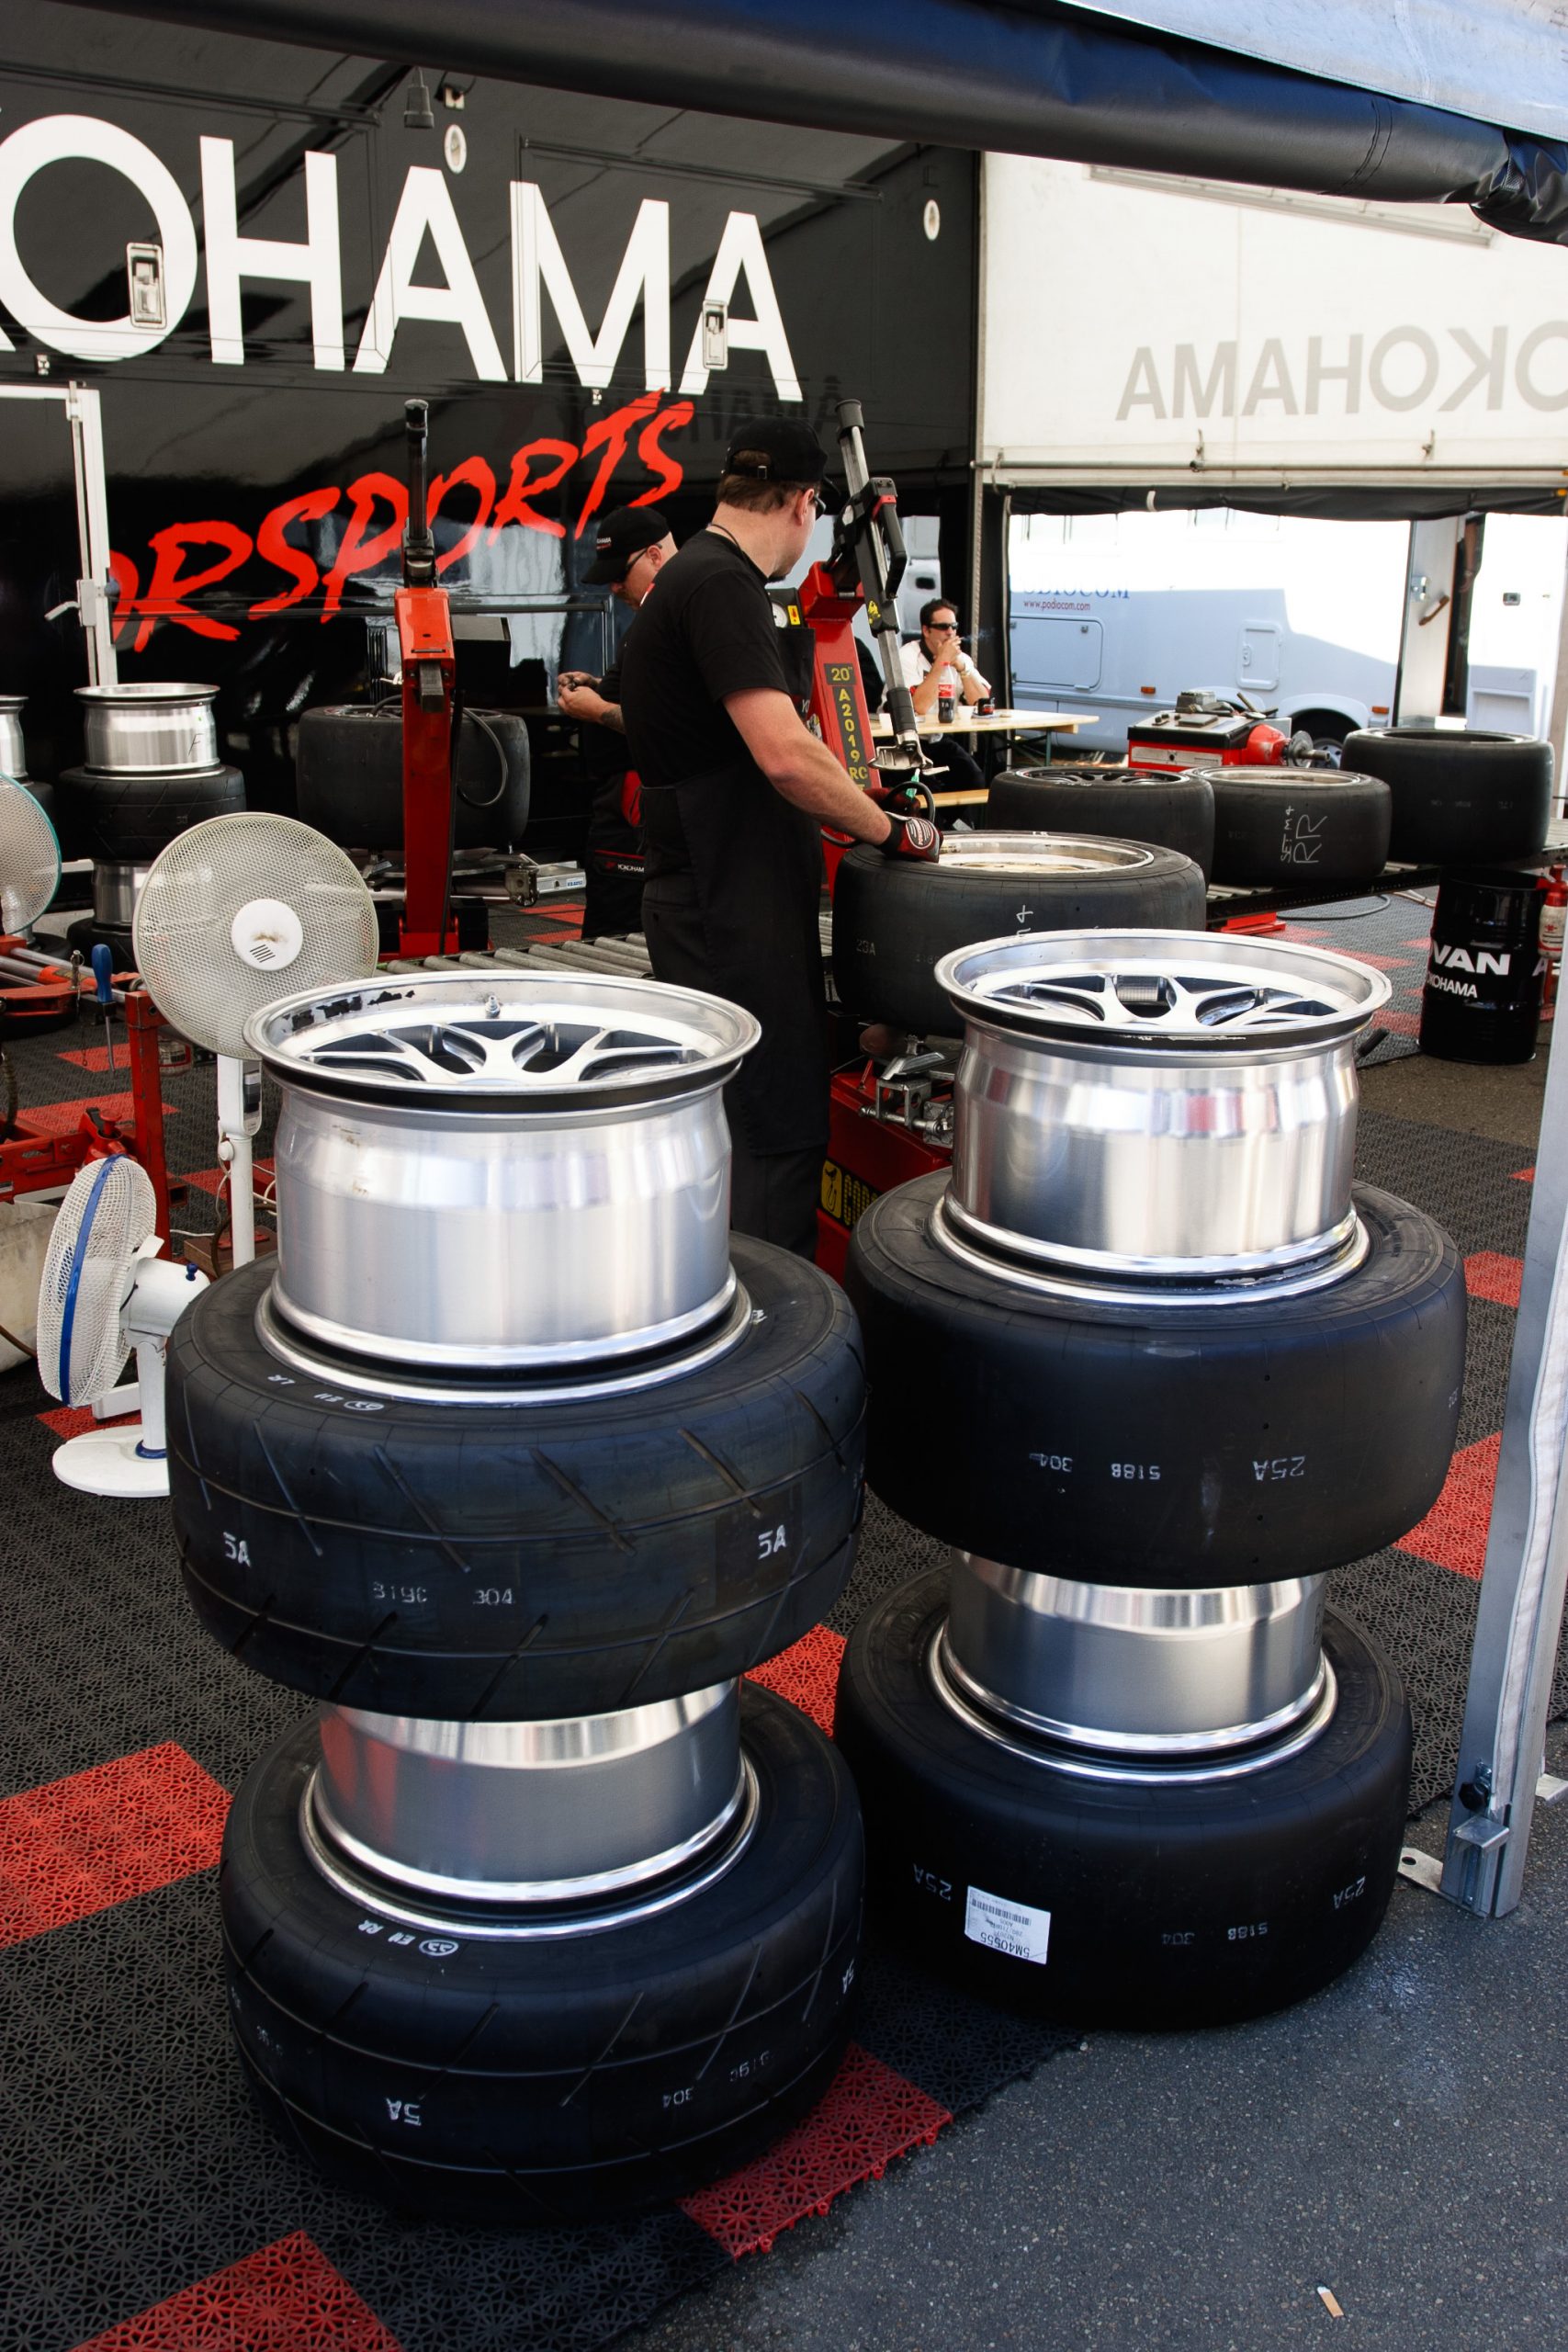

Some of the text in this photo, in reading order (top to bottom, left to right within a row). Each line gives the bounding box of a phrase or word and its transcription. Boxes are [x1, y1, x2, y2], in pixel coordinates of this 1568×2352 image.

[0, 108, 802, 401] OHAMA
[1022, 598, 1091, 611] www.podiocom.com
[1111, 1463, 1161, 1481] 518B
[1252, 1455, 1305, 1482] 25A
[758, 1524, 788, 1560] 5A
[913, 1863, 953, 1902] 25A
[385, 2098, 422, 2127] 5A
